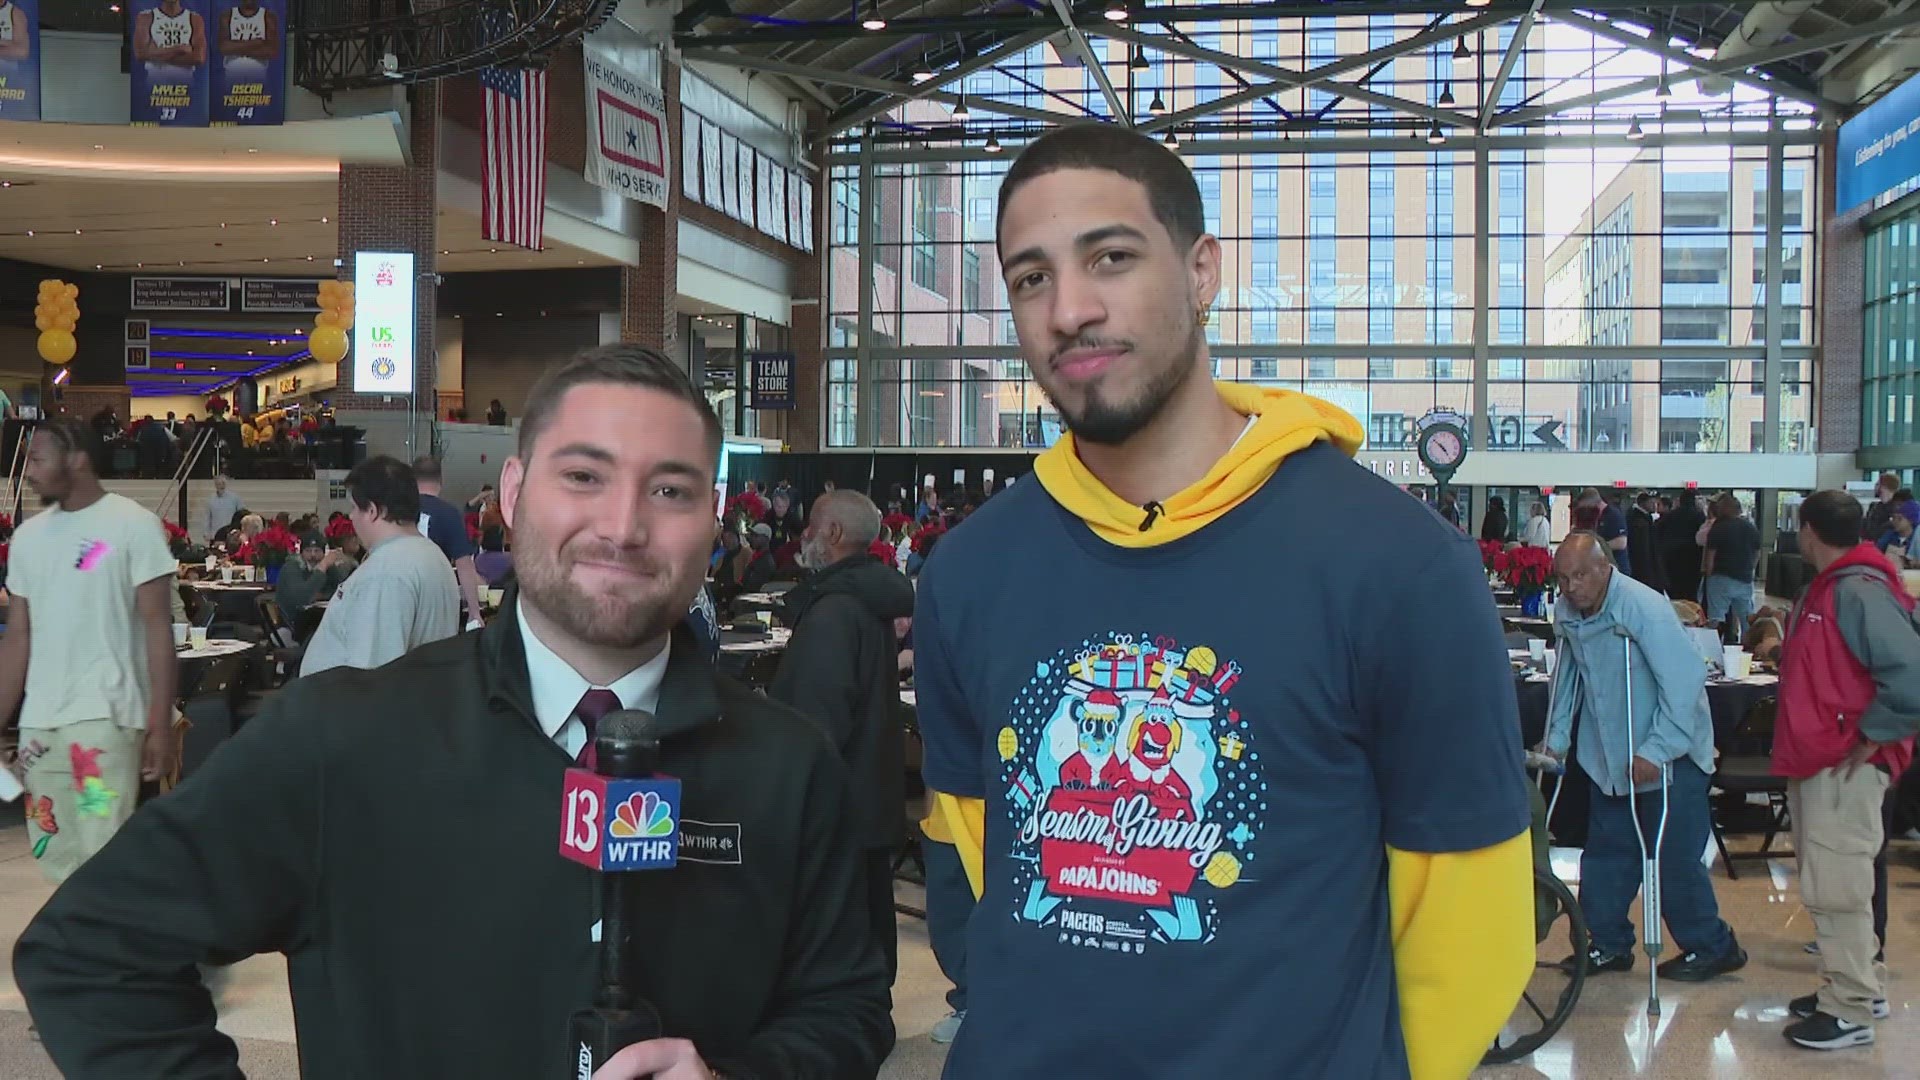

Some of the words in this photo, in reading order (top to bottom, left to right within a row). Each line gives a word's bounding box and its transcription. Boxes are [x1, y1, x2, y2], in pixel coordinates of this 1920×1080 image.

[152, 84, 188, 96] MYLES
[231, 83, 263, 95] OSCAR
[603, 66, 636, 99] HONOR
[150, 95, 191, 107] TURNER
[160, 107, 177, 120] 33
[237, 106, 254, 119] 44
[131, 347, 144, 363] 19
[758, 360, 789, 376] TEAM
[757, 377, 788, 391] STORE
[564, 786, 599, 853] 13
[1021, 791, 1112, 845] Season
[1112, 793, 1224, 868] Giving
[607, 840, 672, 863] WTHR
[1060, 908, 1104, 934] PACERS
